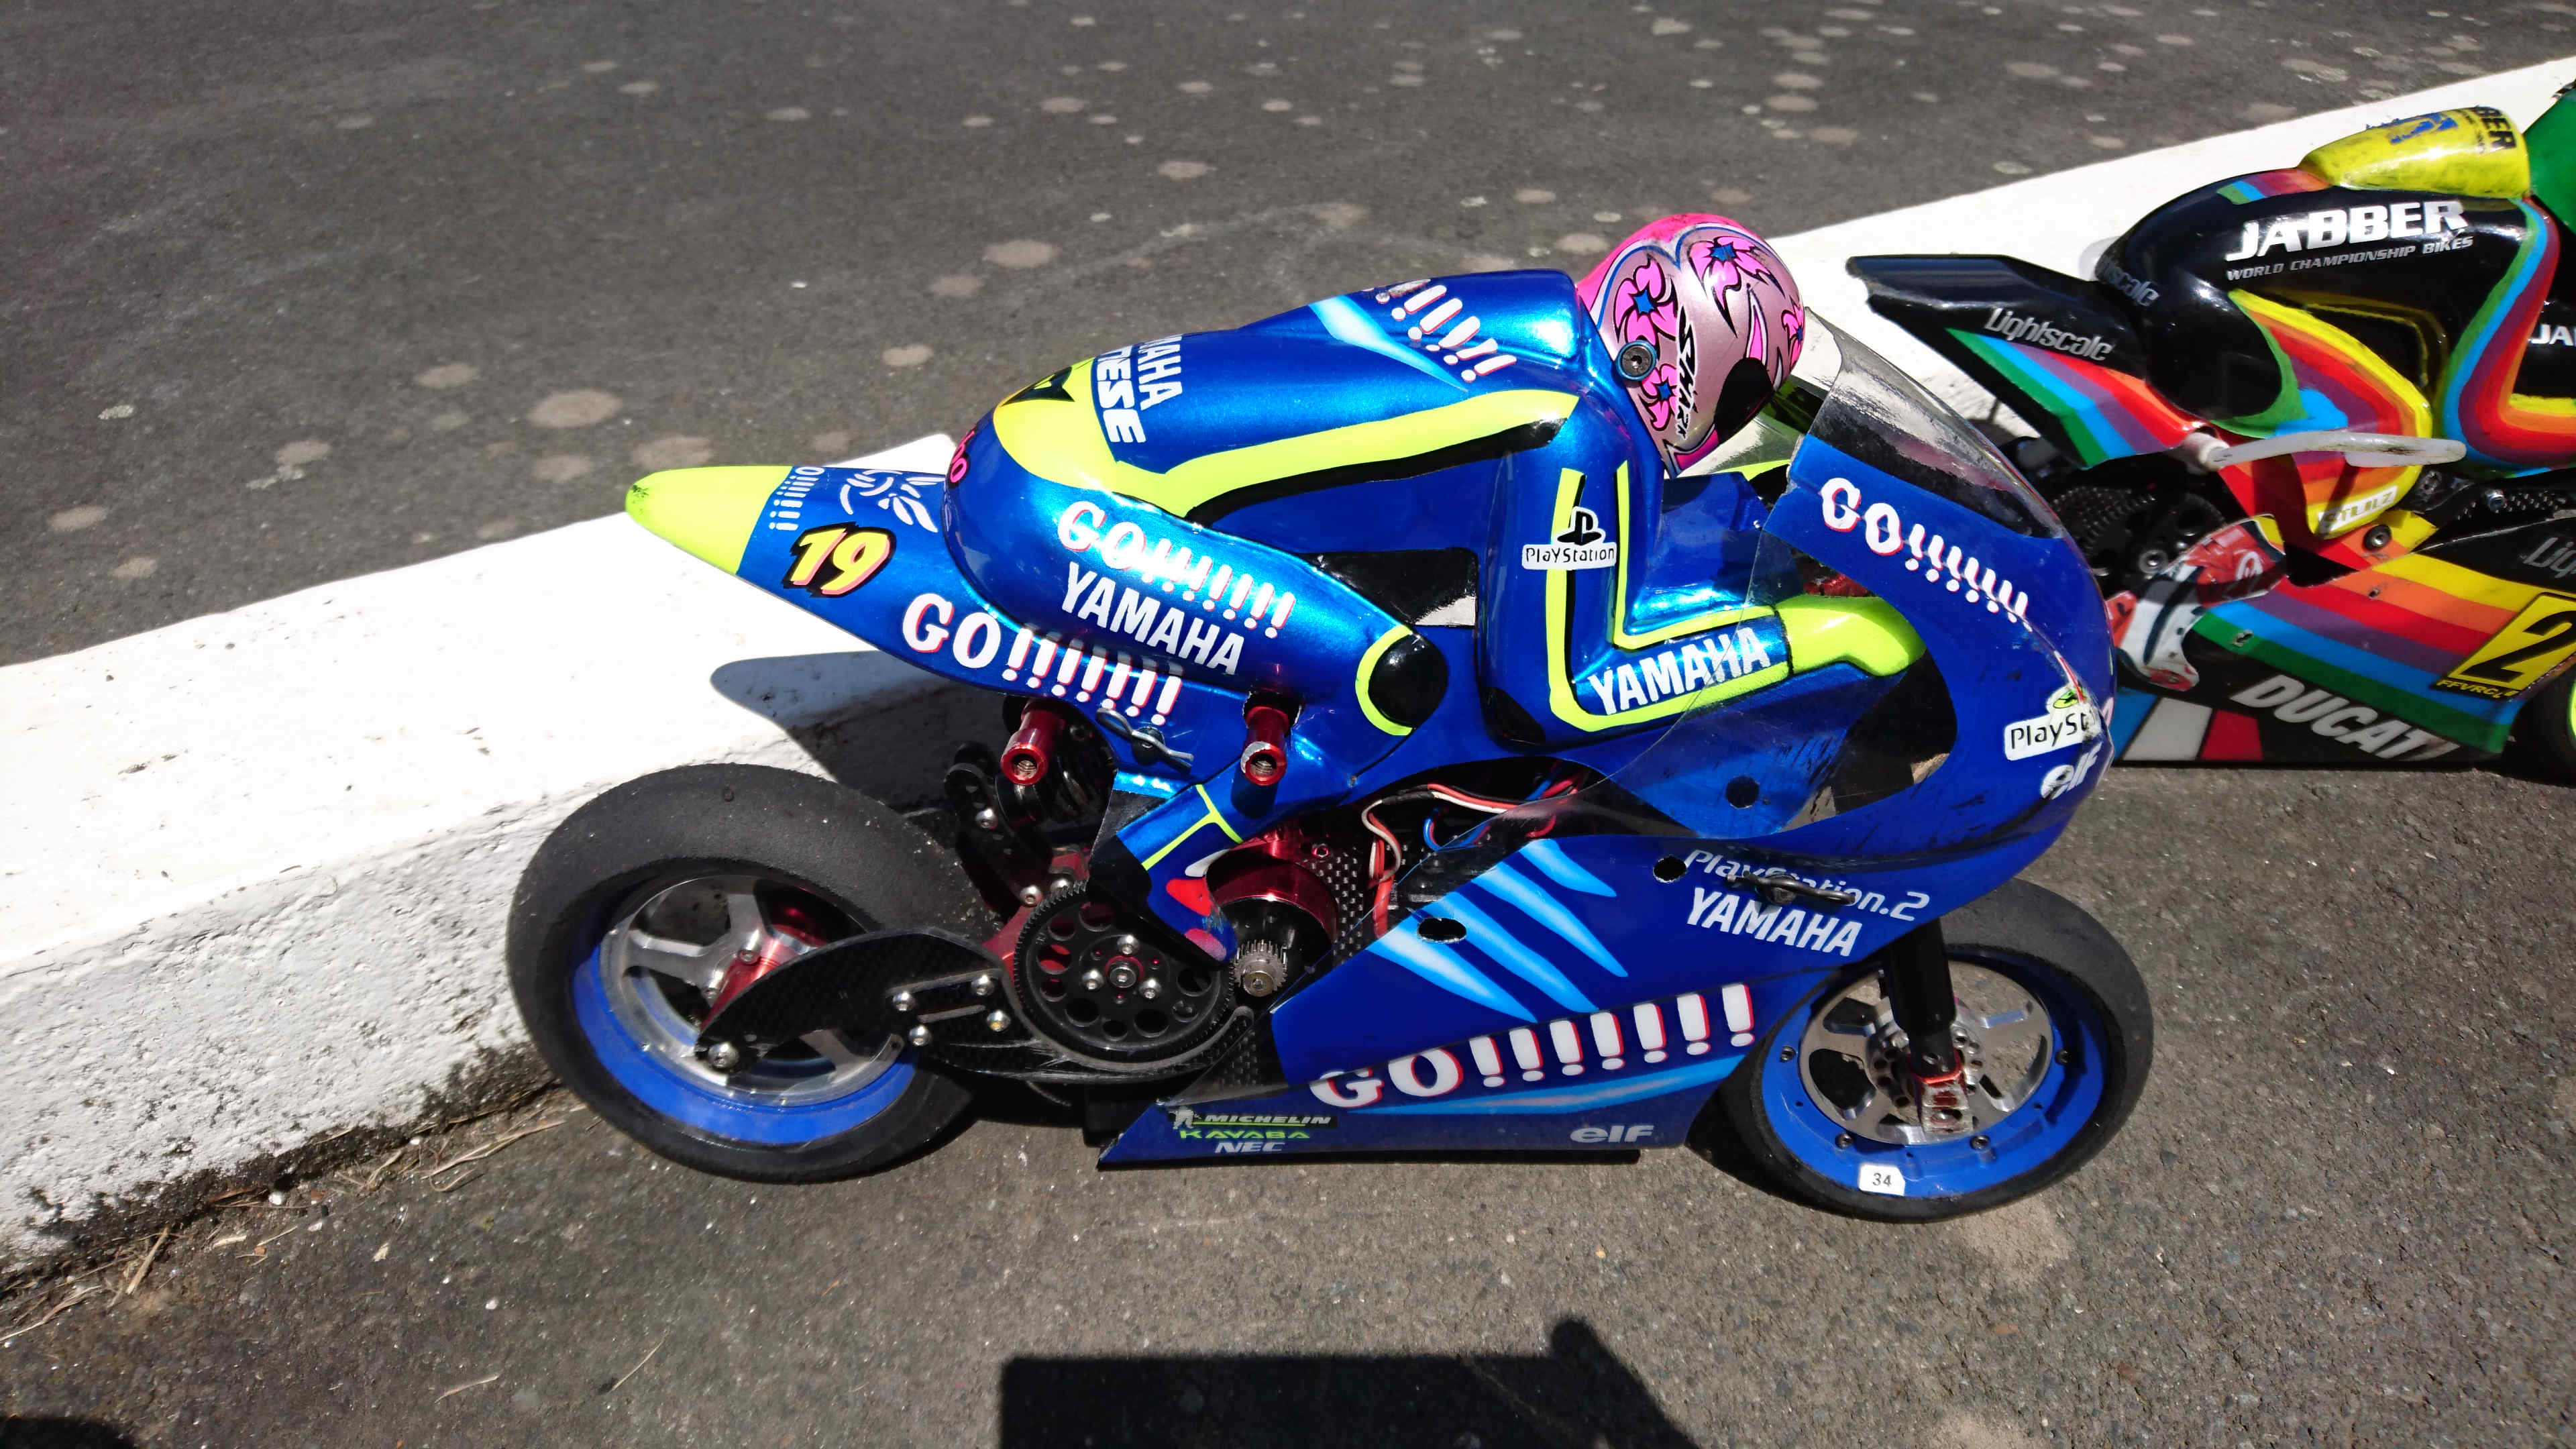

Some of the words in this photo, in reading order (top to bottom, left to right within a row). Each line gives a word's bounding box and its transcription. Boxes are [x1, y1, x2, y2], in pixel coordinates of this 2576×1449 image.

[2225, 199, 2468, 261] JABBER
[2227, 263, 2284, 280] WORLD
[2290, 246, 2415, 271] CHAMPIONSHIP
[2422, 235, 2473, 255] BIKES
[2528, 324, 2576, 347] JA
[788, 525, 894, 596] 19
[1062, 561, 1244, 675] YAMAHA
[1587, 627, 1771, 715] YAMAHA
[1686, 887, 1863, 957] YAMAHA
[1179, 1130, 1310, 1139] KAYABA
[1204, 1114, 1332, 1125] MICHELIN
[1570, 1125, 1655, 1143] elf
[1215, 1141, 1286, 1154] NEC
[1872, 1172, 1892, 1187] 34
